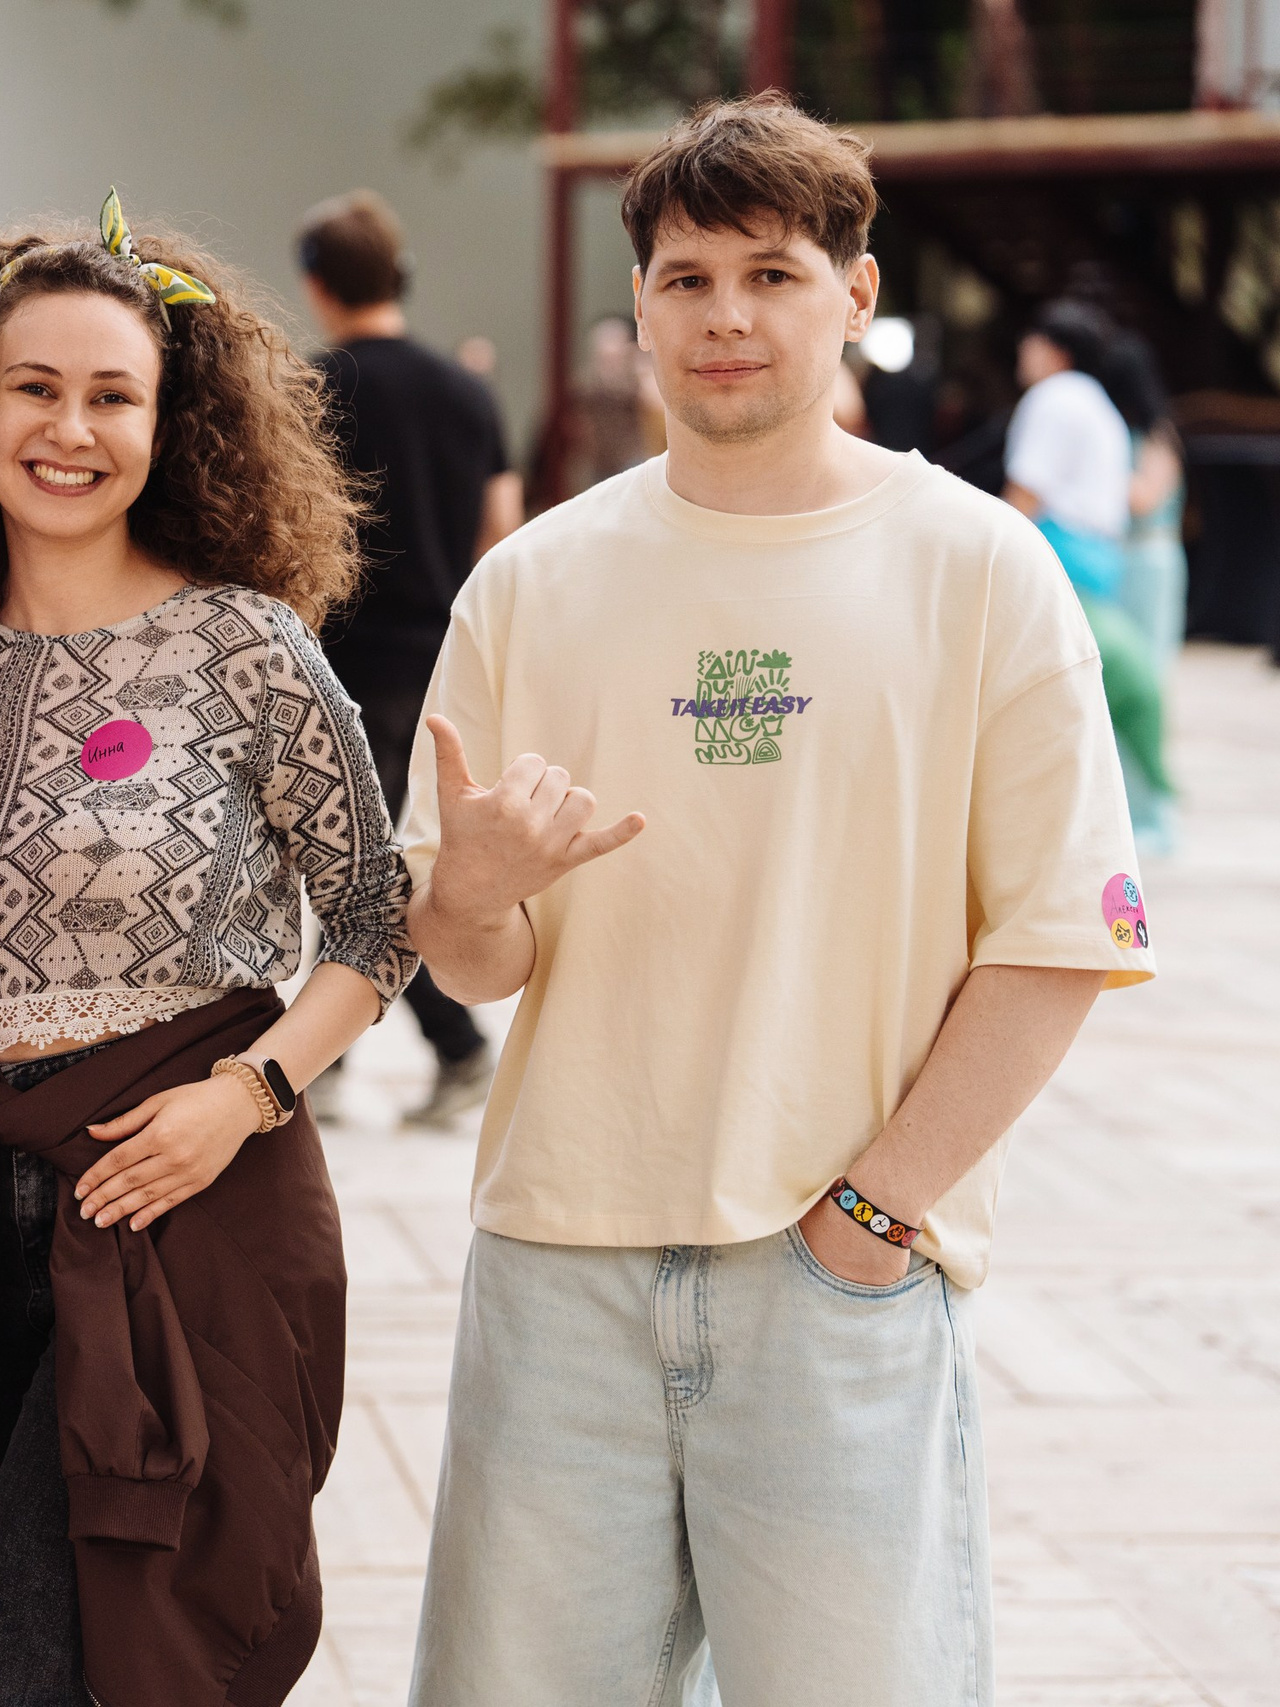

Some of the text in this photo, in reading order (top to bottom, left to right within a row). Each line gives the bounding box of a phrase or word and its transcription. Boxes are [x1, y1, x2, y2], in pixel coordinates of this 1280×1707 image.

[670, 695, 813, 718] TAKE IT EASY
[88, 741, 125, 764] Инна
